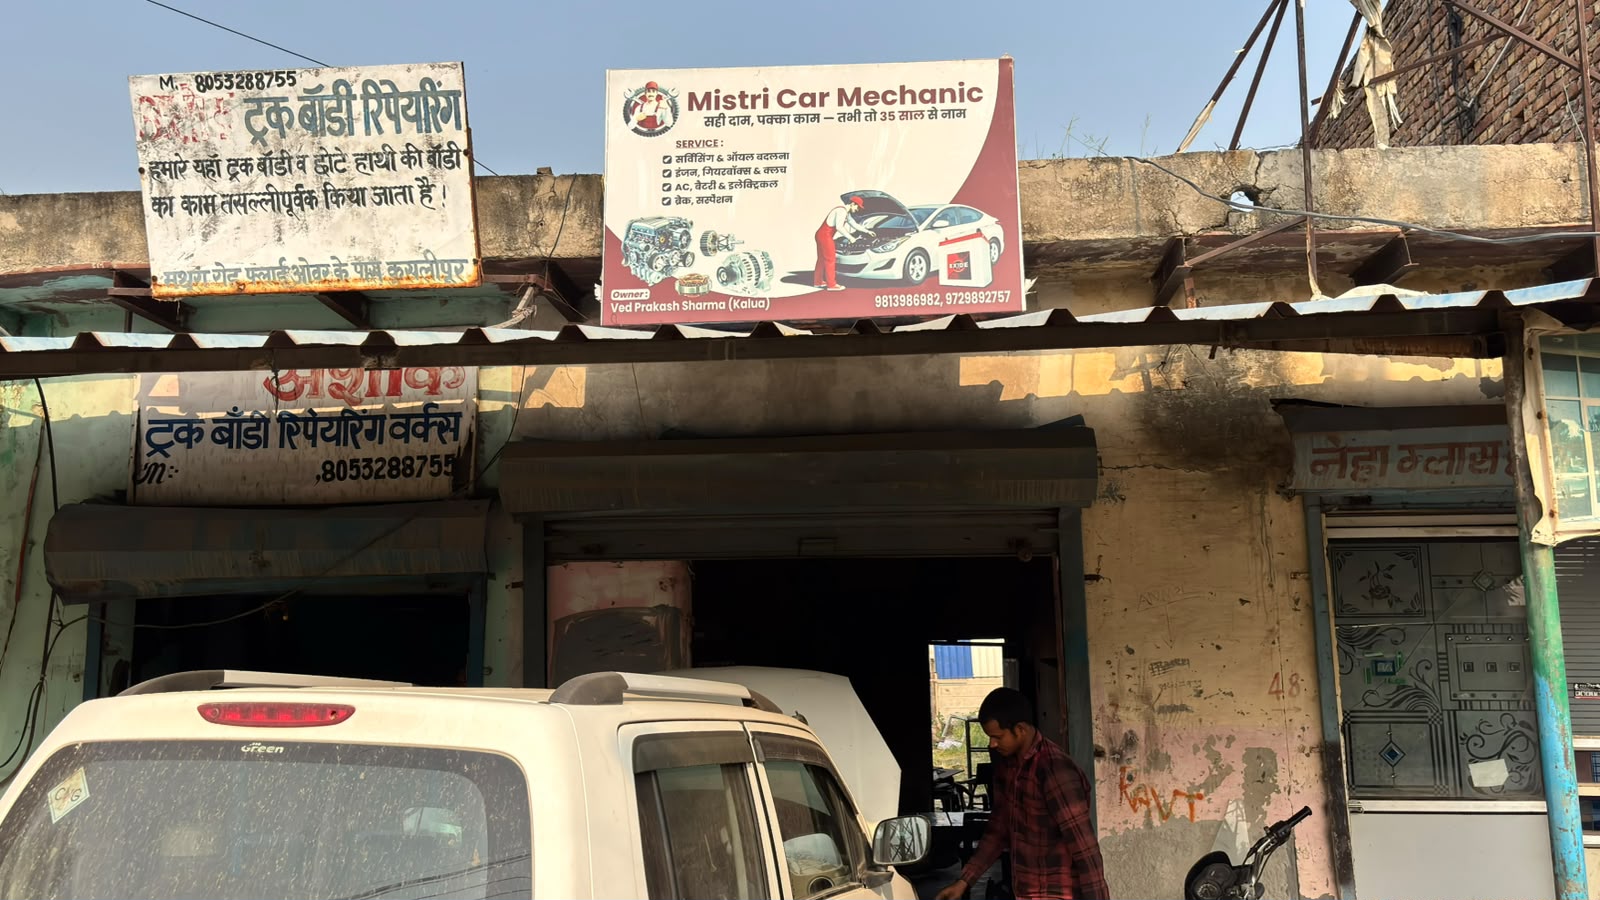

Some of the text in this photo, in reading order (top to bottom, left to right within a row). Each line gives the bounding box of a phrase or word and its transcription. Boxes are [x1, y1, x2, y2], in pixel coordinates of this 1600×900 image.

[195, 71, 297, 93] 8053288755
[688, 81, 984, 112] Mistri Car Mechanic
[244, 96, 294, 147] ट्रक
[297, 78, 357, 137] बॉडी
[360, 76, 462, 136] रिपेयरिंग
[704, 113, 726, 128] सही
[728, 114, 754, 127] दाम,
[757, 114, 791, 126] पक्का
[793, 113, 821, 124] काम
[837, 108, 862, 123] तभी
[864, 108, 878, 122] तो
[880, 110, 896, 122] 35
[898, 110, 925, 121] साल
[927, 106, 941, 120] से
[941, 108, 967, 119] नाम
[149, 152, 189, 183] हमारे
[226, 156, 254, 182] ट्रक
[257, 149, 293, 177] बॉडी
[296, 155, 309, 174] व
[352, 143, 398, 176] हाथी
[400, 142, 425, 170] की
[426, 140, 463, 171] बॉडी
[716, 154, 724, 162] &
[727, 151, 754, 162] ऑयल
[756, 152, 790, 161] बदलना
[702, 165, 752, 177] गियरबॉक्स
[753, 167, 761, 175] &
[763, 166, 787, 175] क्लच
[675, 183, 693, 192] AC,
[718, 182, 726, 190] &
[728, 179, 778, 190] इलेक्ट्रिकल
[151, 196, 175, 219] का
[180, 193, 217, 217] काम
[221, 183, 319, 221] तसल्लीपूर्वक
[322, 181, 368, 210] किया
[371, 184, 415, 206] जाता
[331, 255, 349, 282] के
[611, 297, 770, 313] Ved Prakash Sharma (Kalua)
[875, 290, 1011, 308] 9813986982, 9729892757
[145, 418, 206, 459] ट्रक
[277, 407, 387, 450] रिपेयरिंग
[389, 402, 463, 445] वर्क्स
[1310, 434, 1390, 482] नेहा
